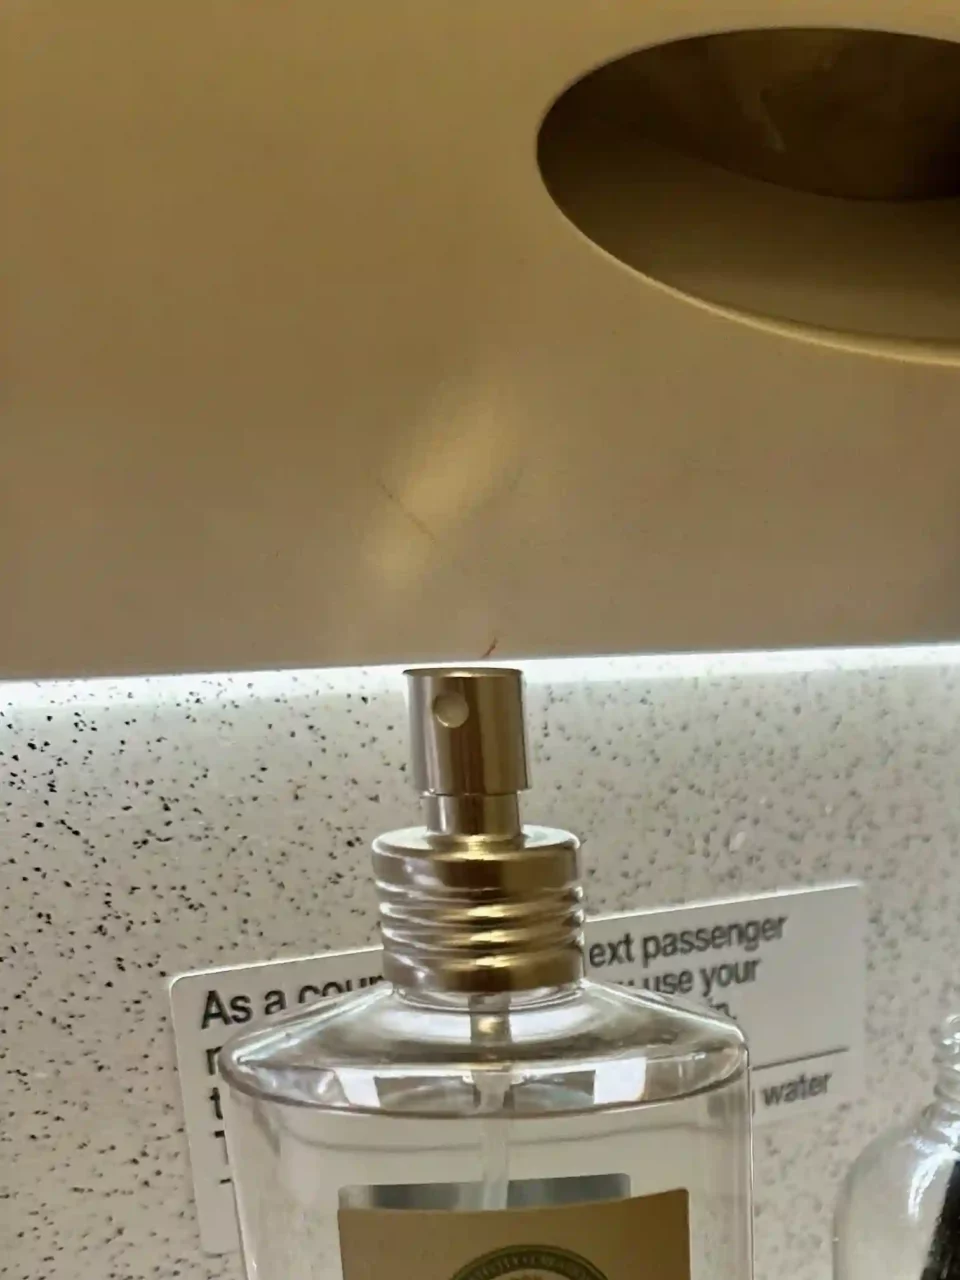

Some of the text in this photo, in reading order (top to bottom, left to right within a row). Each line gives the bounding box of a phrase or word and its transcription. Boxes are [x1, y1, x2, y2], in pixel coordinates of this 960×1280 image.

[201, 989, 253, 1029] As
[264, 989, 287, 1016] a
[589, 933, 634, 968] ext
[643, 914, 788, 968] passenger
[643, 957, 762, 997] use your
[762, 1072, 832, 1106] water
